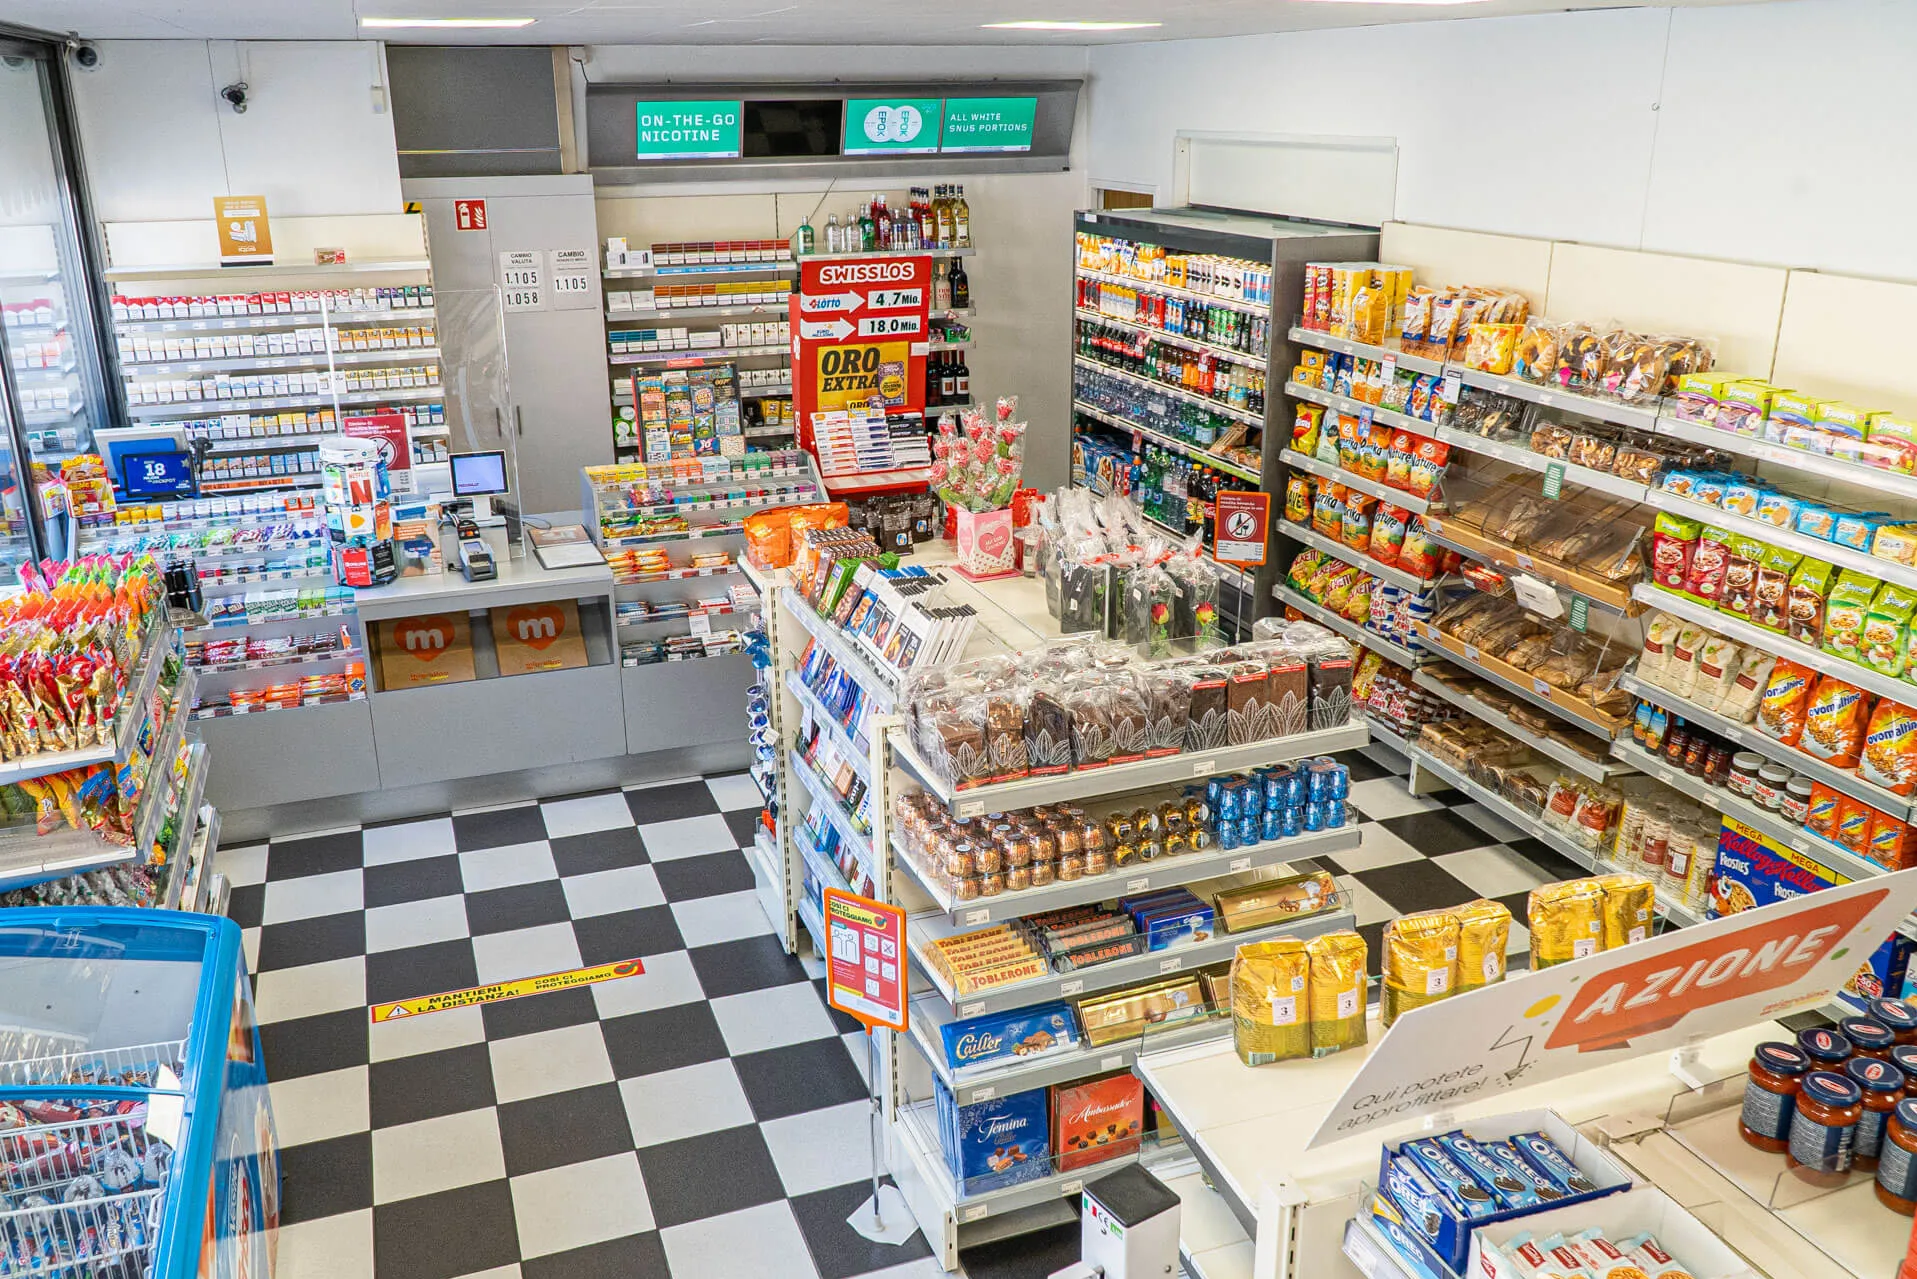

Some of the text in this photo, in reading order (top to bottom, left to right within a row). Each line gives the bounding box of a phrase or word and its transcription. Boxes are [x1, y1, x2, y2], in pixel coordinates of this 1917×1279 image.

[641, 114, 735, 127] ON-THE-GO
[877, 111, 887, 137] EPOK
[900, 111, 910, 137] EPOK
[949, 123, 1028, 132] SNUS PORTIONS
[950, 113, 1001, 122] ALL WHITE
[641, 130, 720, 142] NICOTINE
[558, 250, 585, 258] CAMBIO
[505, 271, 537, 284] 1.105
[555, 277, 587, 291] 1.105
[821, 264, 914, 283] SWISSLOS
[506, 291, 538, 305] 1.058
[901, 293, 920, 305] Mio.
[821, 347, 881, 376] ORO
[821, 375, 880, 393] EXTRA
[144, 463, 166, 476] 18
[1763, 678, 1805, 699] vomaltine
[1867, 719, 1917, 745] ovomaltin
[1736, 823, 1763, 843] MEGA
[1719, 851, 1750, 876] FROSTIES
[1791, 852, 1820, 873] MEGA
[1069, 943, 1134, 968] TOBLERONE
[536, 972, 612, 989] PROTEGGIAMO
[970, 964, 1038, 989] TOBLERONE
[1434, 976, 1442, 987] 3
[1574, 924, 1840, 1025] AZIONE
[418, 989, 520, 1013] LA DISTANZA!
[429, 985, 502, 1004] MANTIENI
[1344, 998, 1352, 1009] 3
[1280, 1006, 1289, 1016] 3
[956, 1031, 1002, 1060] Cailler
[1352, 1063, 1484, 1110] Qui potete
[1337, 1076, 1488, 1131] approfittare!
[1422, 1146, 1472, 1183] OREO
[1453, 1138, 1508, 1178] OREO
[1496, 1145, 1550, 1187] OREO
[1529, 1138, 1584, 1177] OREO
[1389, 1223, 1424, 1263] OREO
